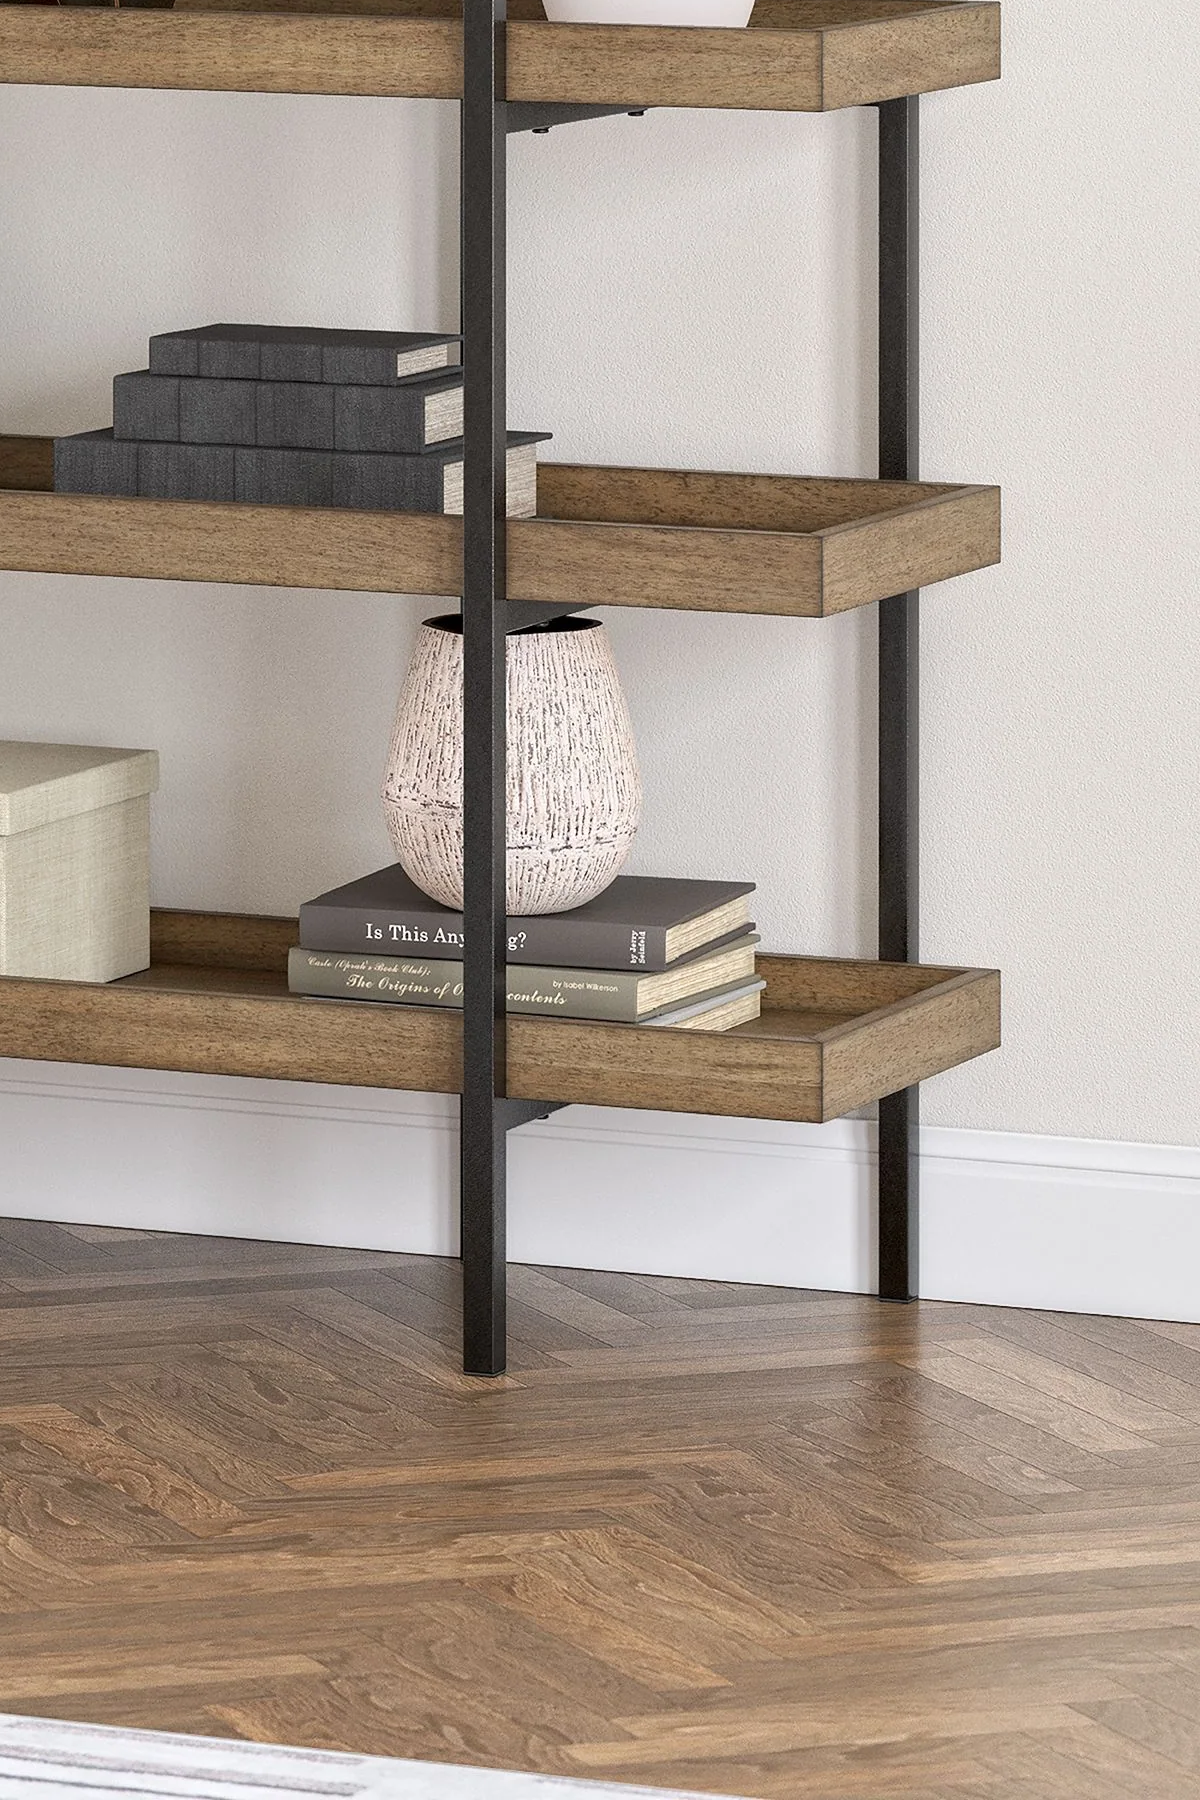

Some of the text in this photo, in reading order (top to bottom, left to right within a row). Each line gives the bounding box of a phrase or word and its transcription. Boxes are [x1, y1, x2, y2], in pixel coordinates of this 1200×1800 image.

[366, 923, 383, 940] Is
[389, 925, 429, 943] This
[629, 930, 639, 953] Jerry
[346, 973, 373, 989] The
[378, 976, 430, 997] Origins
[433, 982, 451, 1000] of
[552, 980, 619, 993] by Isabel Wilkerson
